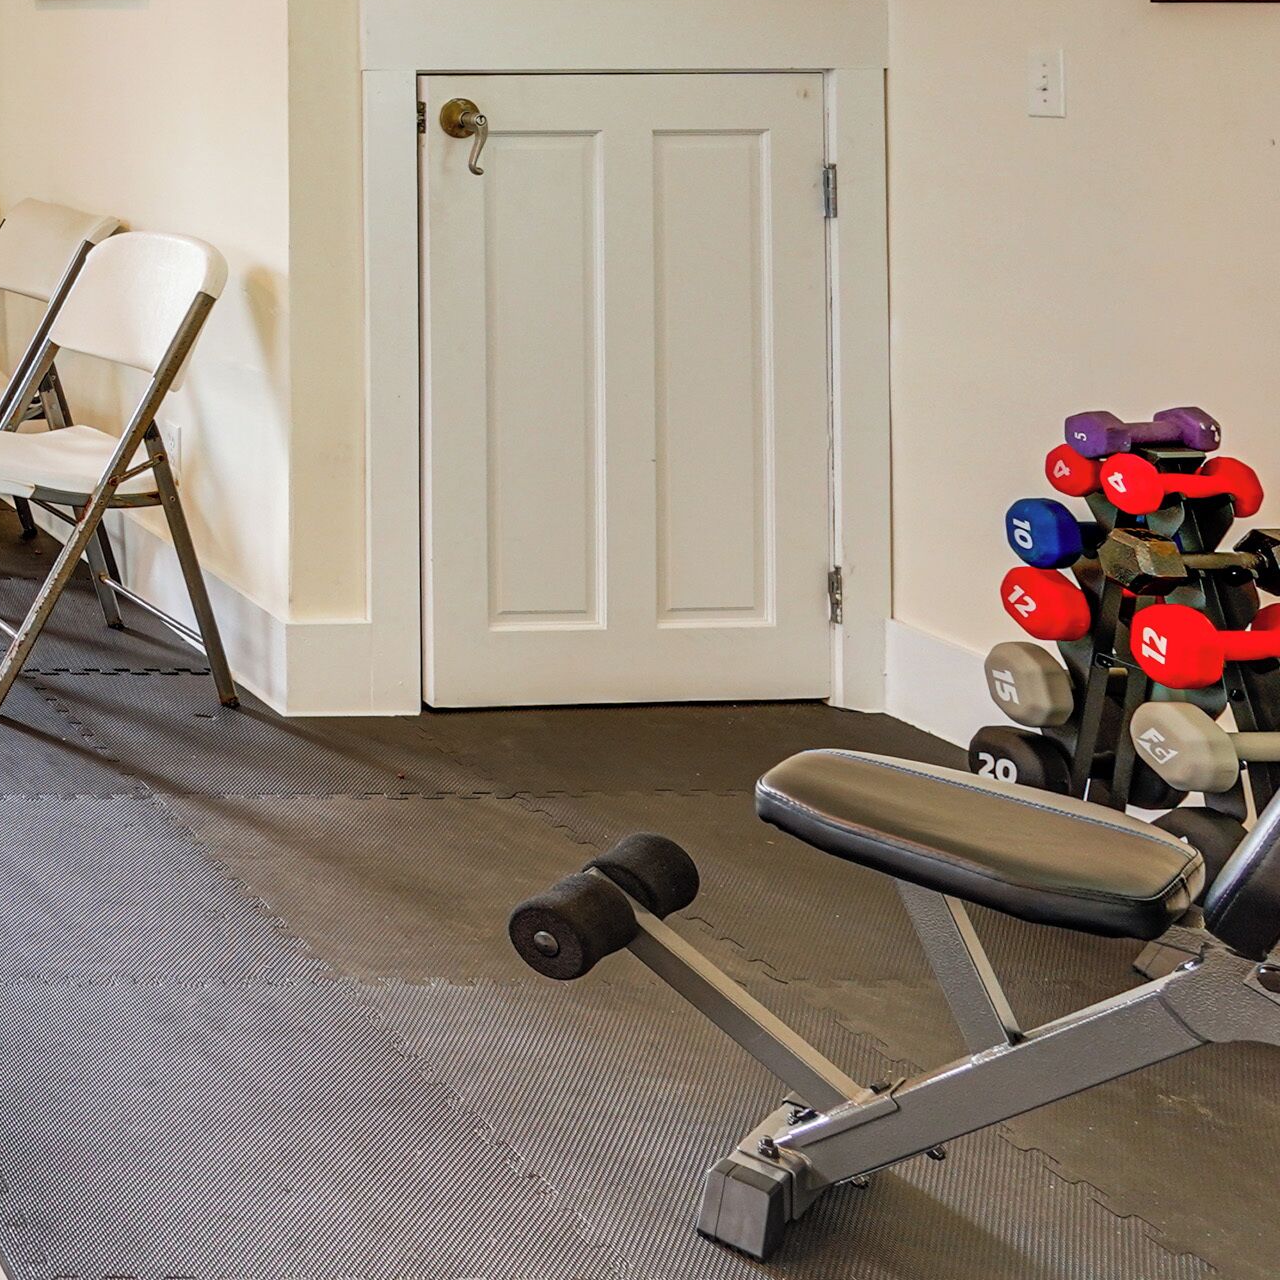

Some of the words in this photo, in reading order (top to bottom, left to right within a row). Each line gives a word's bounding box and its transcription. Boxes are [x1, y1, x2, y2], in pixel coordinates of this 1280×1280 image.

[1074, 431, 1087, 441] 5
[1053, 459, 1071, 479] 4
[1107, 471, 1127, 493] 4
[1012, 517, 1033, 550] 10
[1007, 584, 1037, 618] 12
[1141, 626, 1168, 665] 12
[991, 669, 1020, 705] 15
[977, 752, 1018, 784] 20
